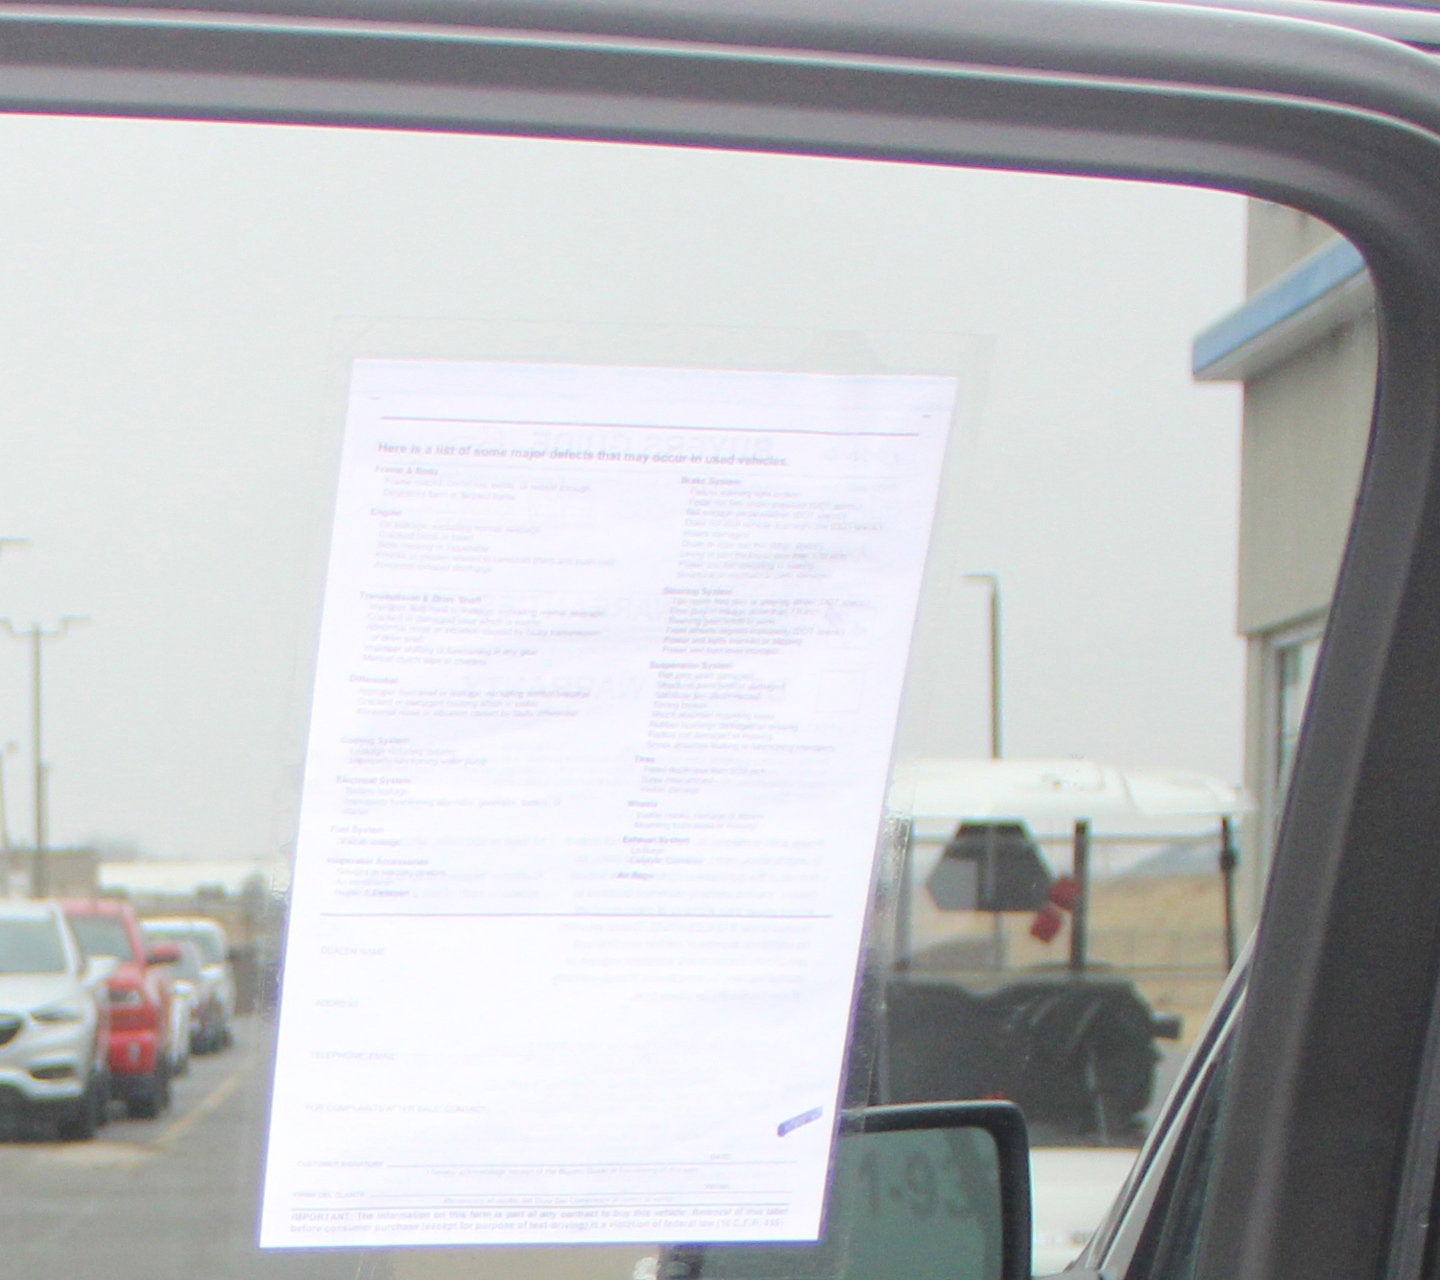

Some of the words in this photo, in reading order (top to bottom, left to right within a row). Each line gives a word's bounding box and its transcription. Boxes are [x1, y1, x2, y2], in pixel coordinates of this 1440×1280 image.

[377, 443, 407, 453] Here
[411, 444, 421, 454] is
[425, 444, 432, 454] a
[437, 444, 455, 455] list
[458, 445, 471, 456] of
[474, 446, 507, 457] some
[510, 447, 546, 461] major
[550, 448, 594, 459] defects
[597, 450, 622, 460] that
[624, 450, 650, 464] may
[652, 451, 688, 462] occur
[691, 452, 702, 463] in
[705, 453, 735, 464] used
